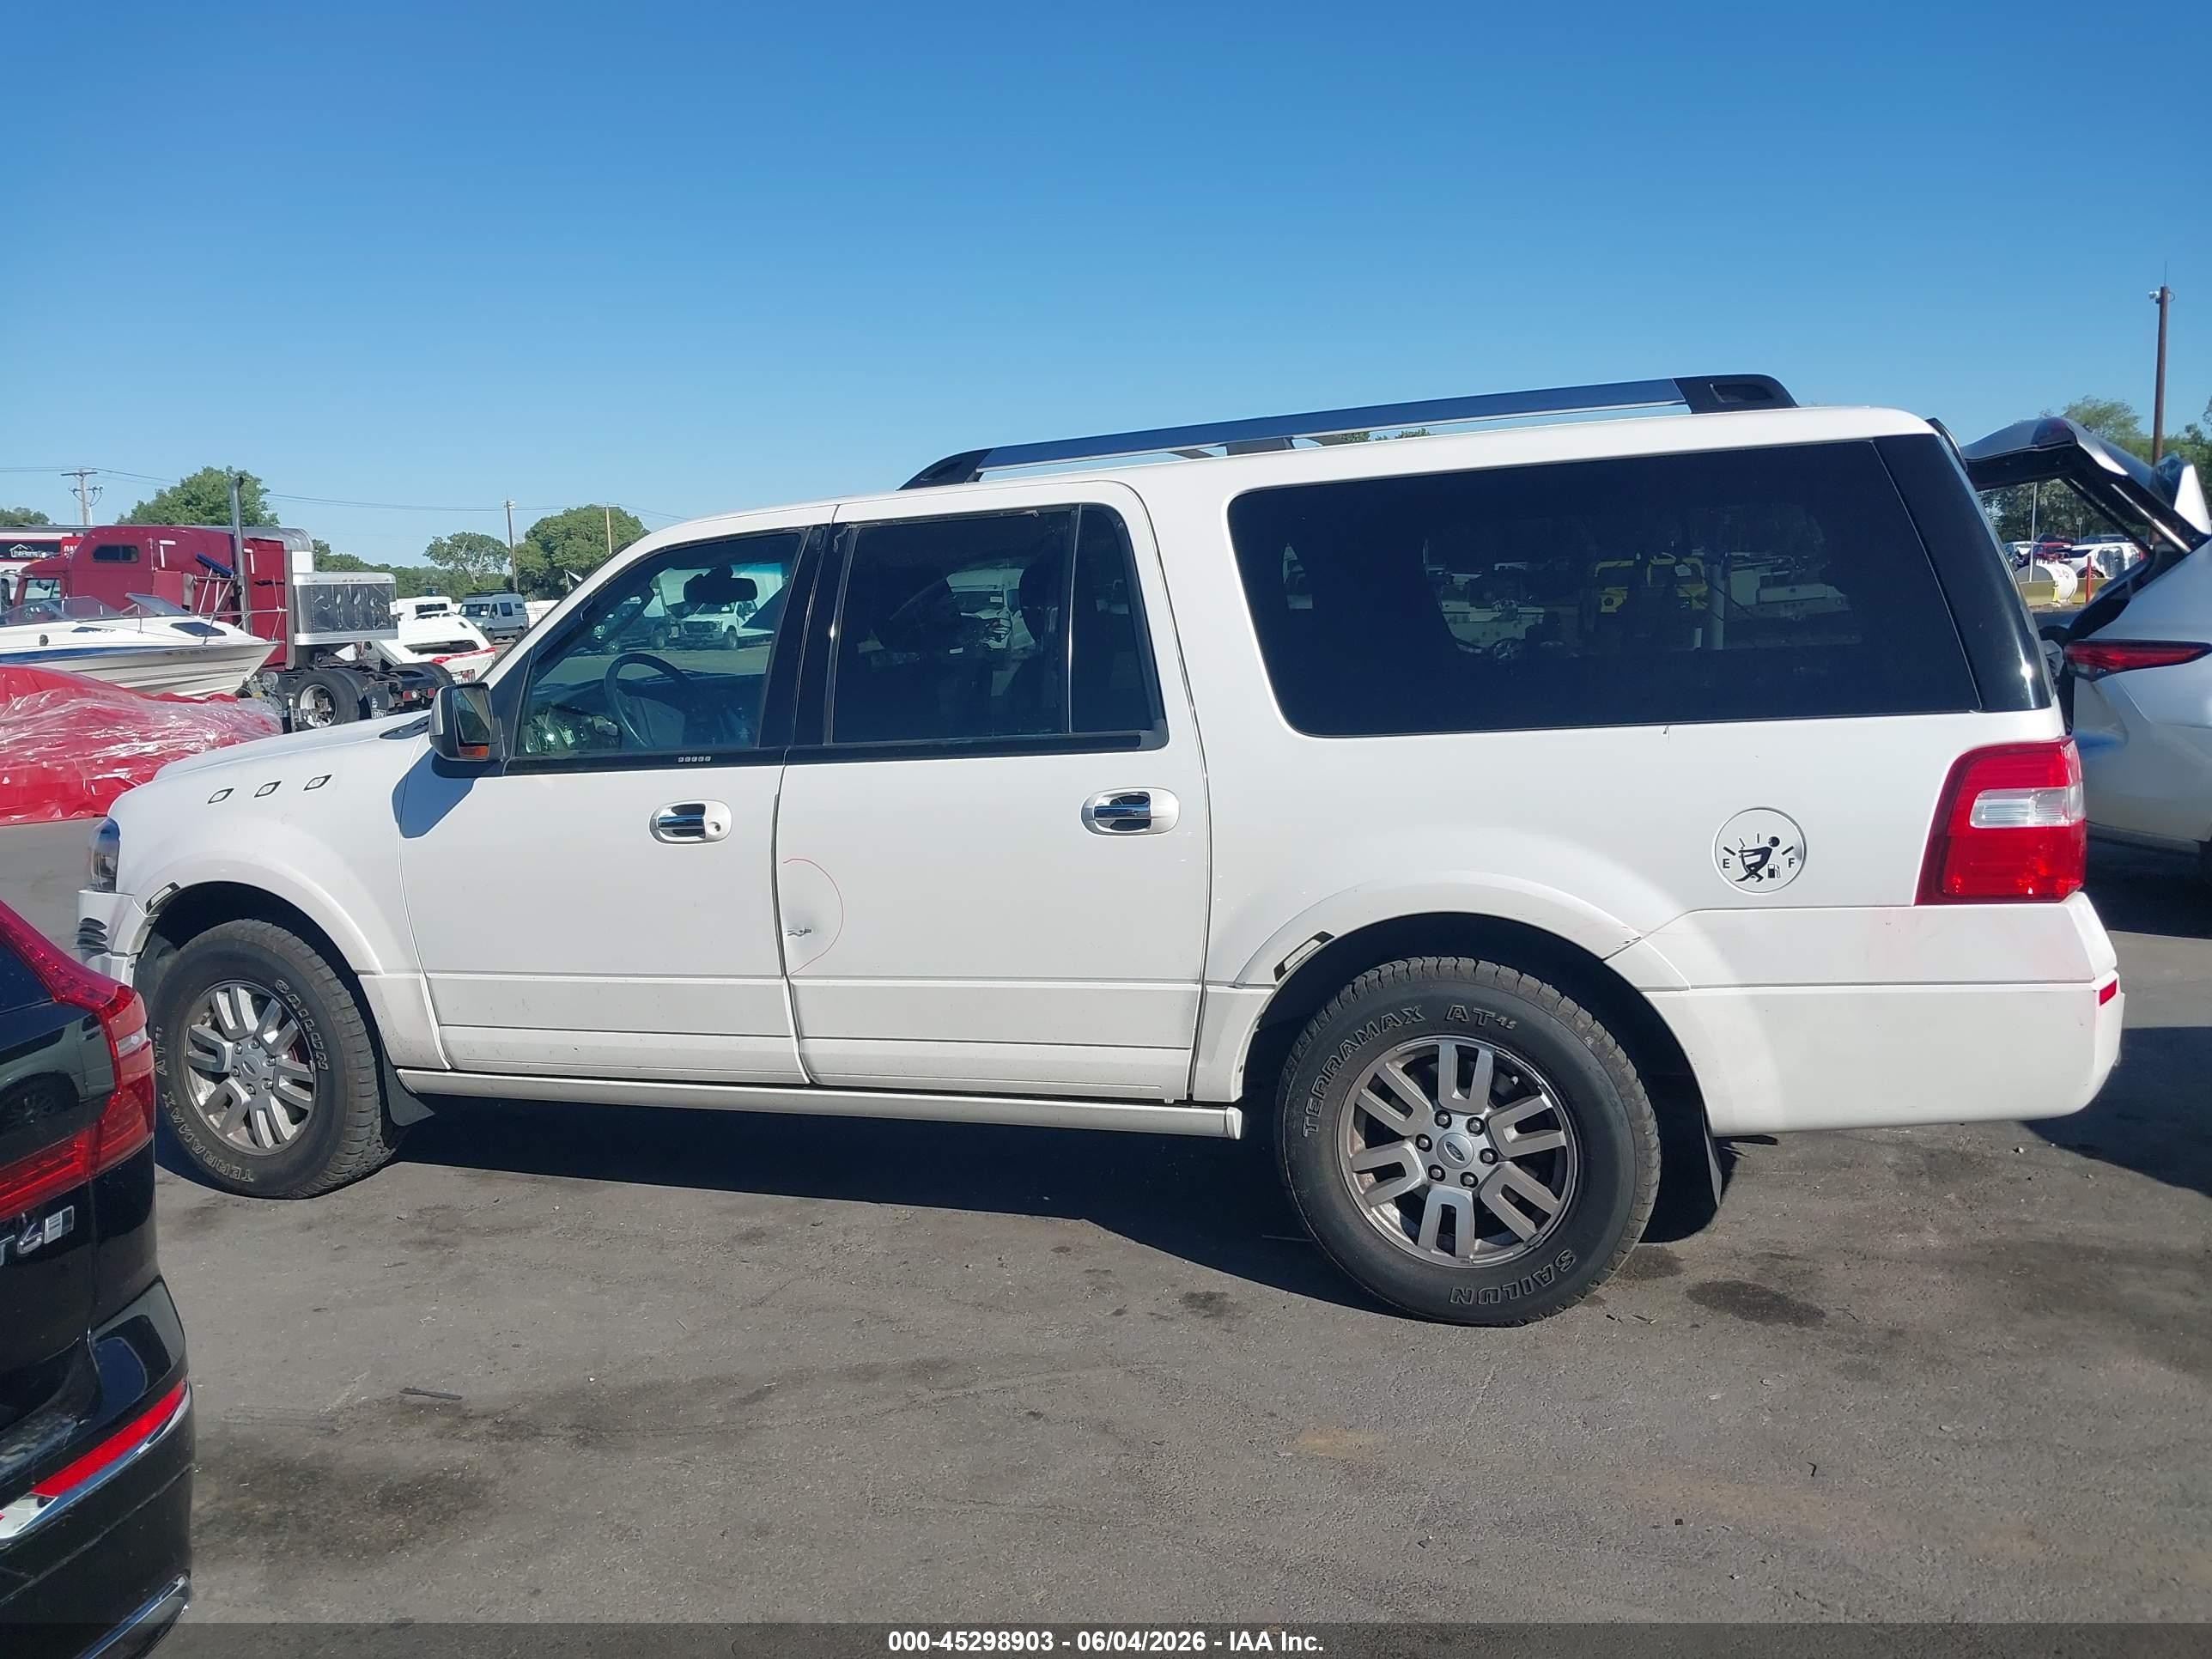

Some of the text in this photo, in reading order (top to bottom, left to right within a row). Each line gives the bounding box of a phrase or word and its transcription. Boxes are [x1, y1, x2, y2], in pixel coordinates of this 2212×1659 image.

[1722, 857, 1796, 869] E F
[1301, 1004, 1426, 1139] TERRAMAX
[1449, 1248, 1577, 1306] SAILUN
